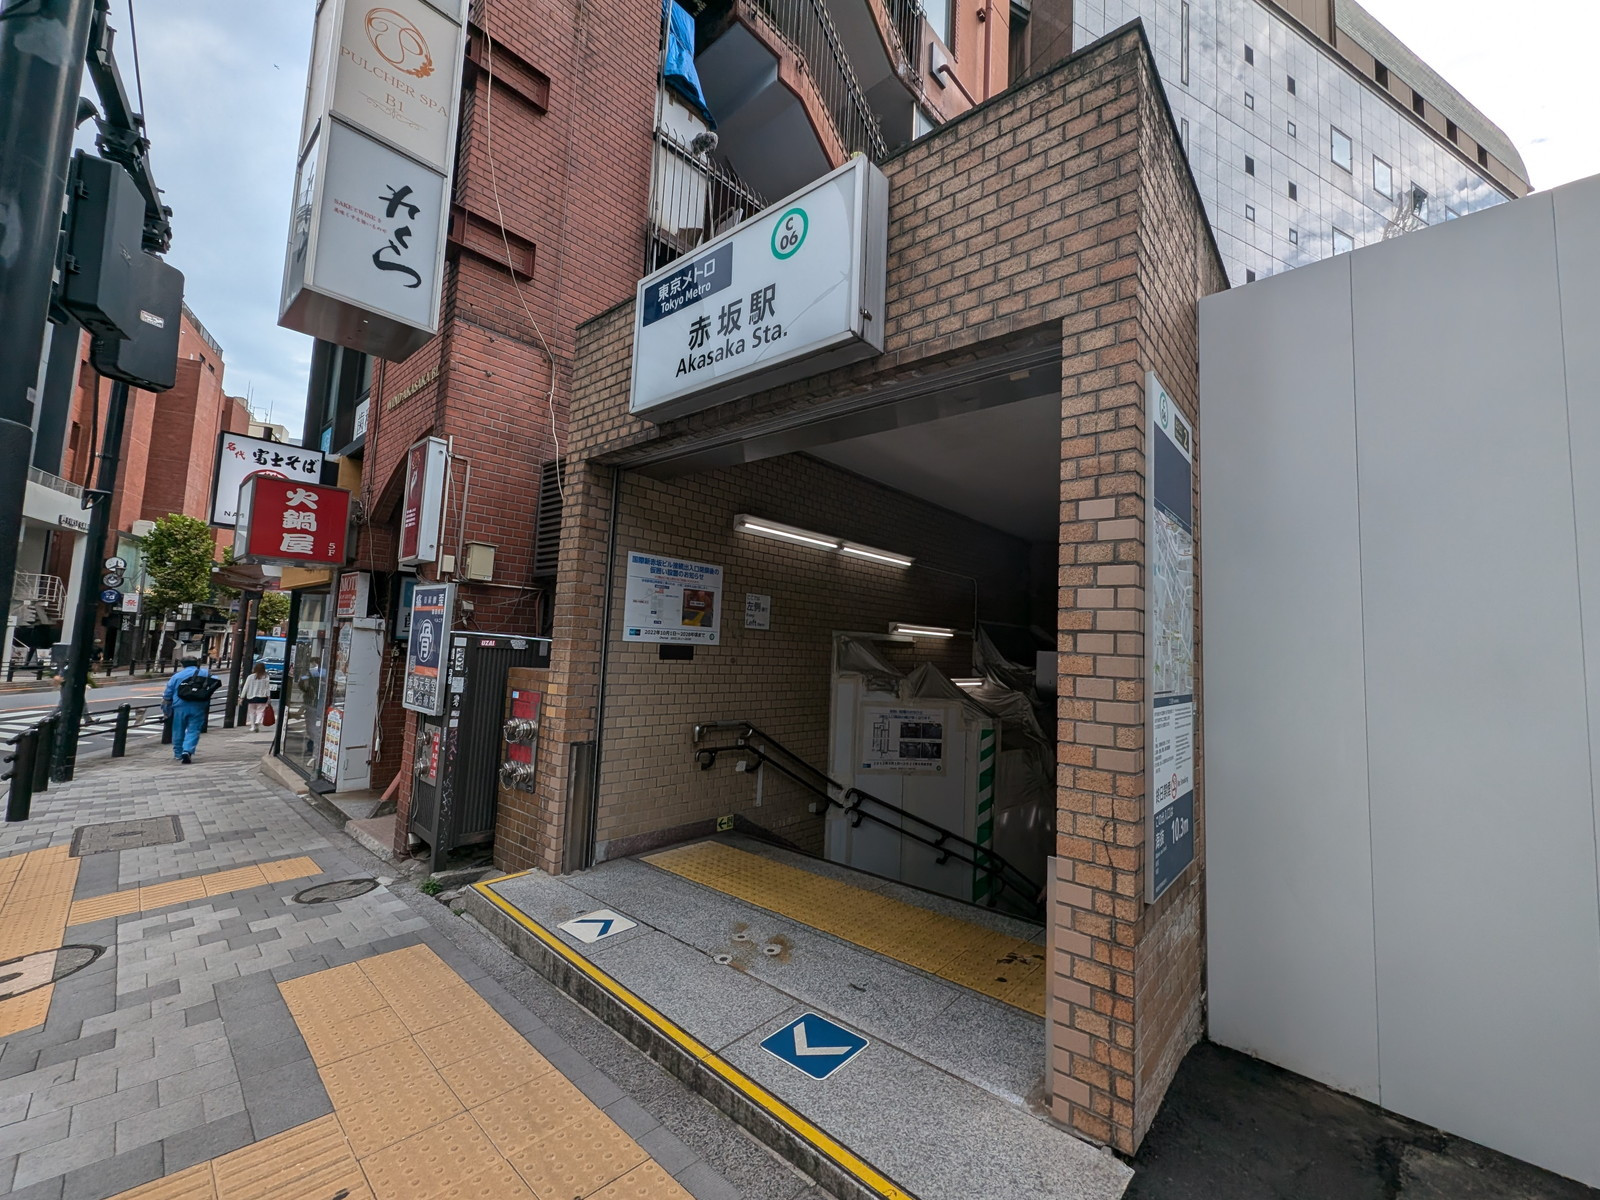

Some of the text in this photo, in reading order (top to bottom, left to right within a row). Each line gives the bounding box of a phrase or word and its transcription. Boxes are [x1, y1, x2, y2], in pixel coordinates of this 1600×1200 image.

[340, 46, 448, 118] PULCHER SPA
[385, 93, 404, 113] B1
[785, 216, 794, 231] C
[780, 231, 799, 251] 06
[658, 257, 716, 303] 東京メトロ
[660, 281, 711, 314] Tokyo Metro
[688, 282, 776, 351] 赤坂駅
[675, 323, 788, 378] Akasaka Sta.
[225, 441, 246, 461] 名代
[279, 487, 319, 555] 火鍋屋
[327, 542, 336, 557] 5F
